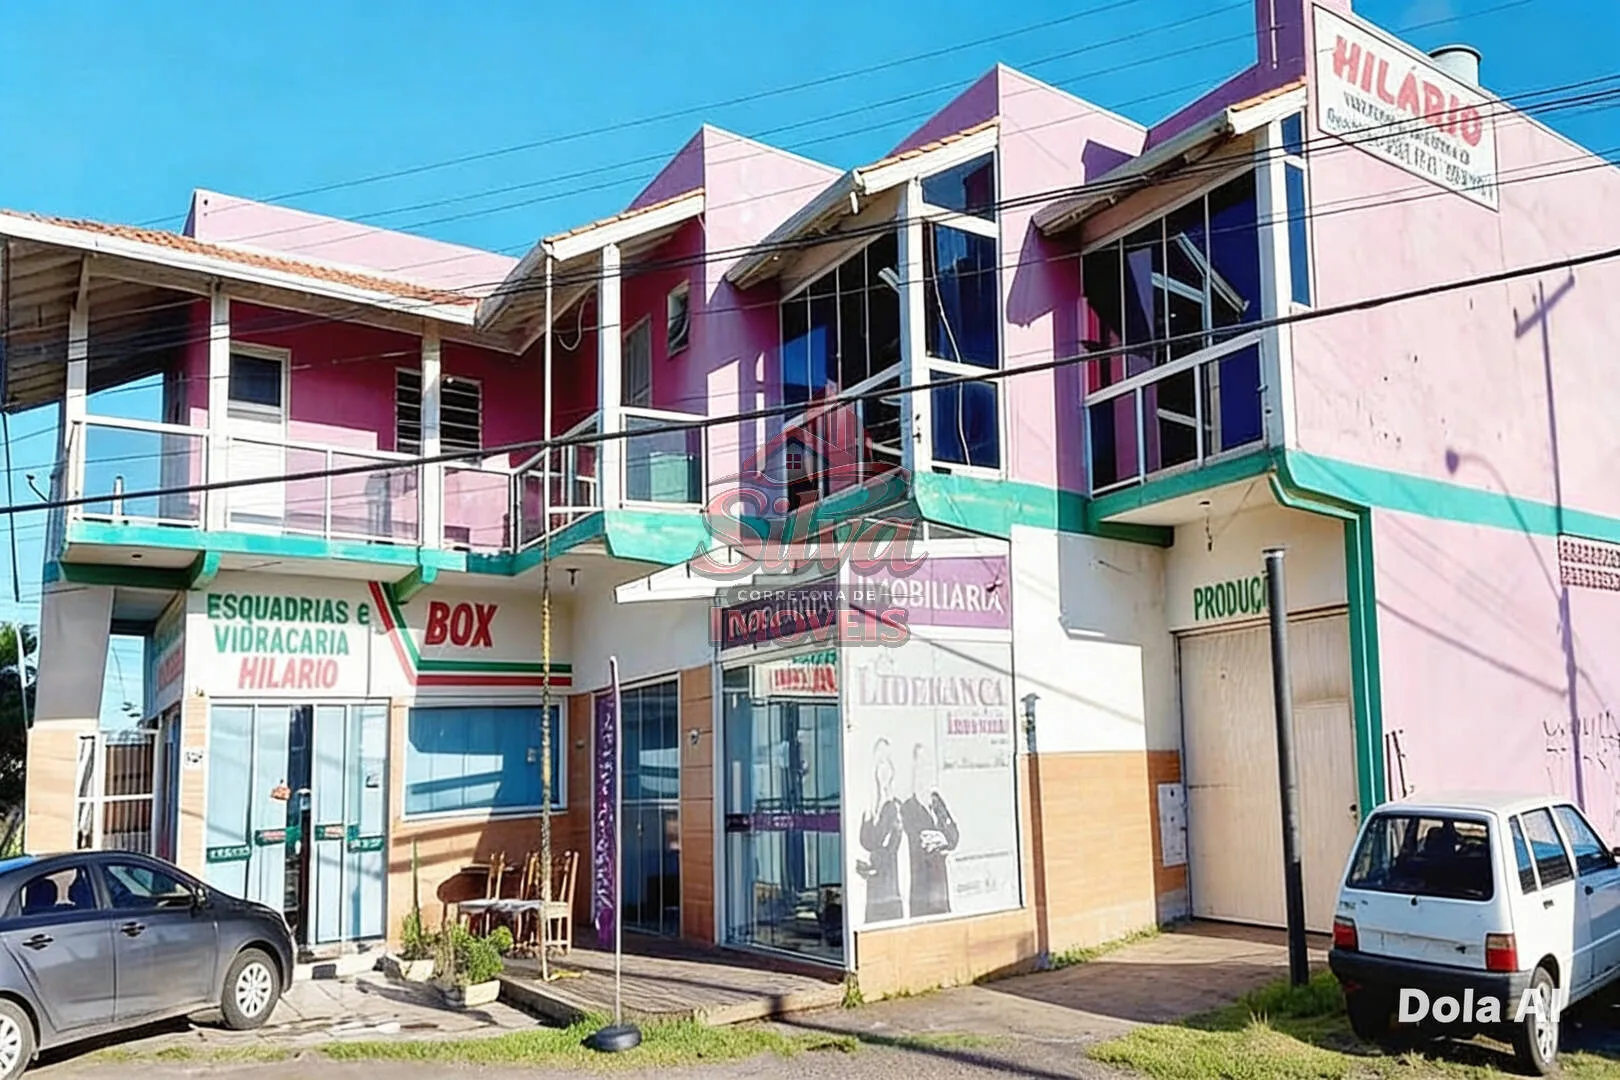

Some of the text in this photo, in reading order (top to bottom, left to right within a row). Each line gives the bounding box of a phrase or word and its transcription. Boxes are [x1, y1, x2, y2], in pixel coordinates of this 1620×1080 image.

[207, 593, 370, 625] ESQUADRIAS e
[424, 600, 498, 649] BOX
[214, 624, 349, 656] VIDRACARIA
[238, 656, 339, 690] HILARIO
